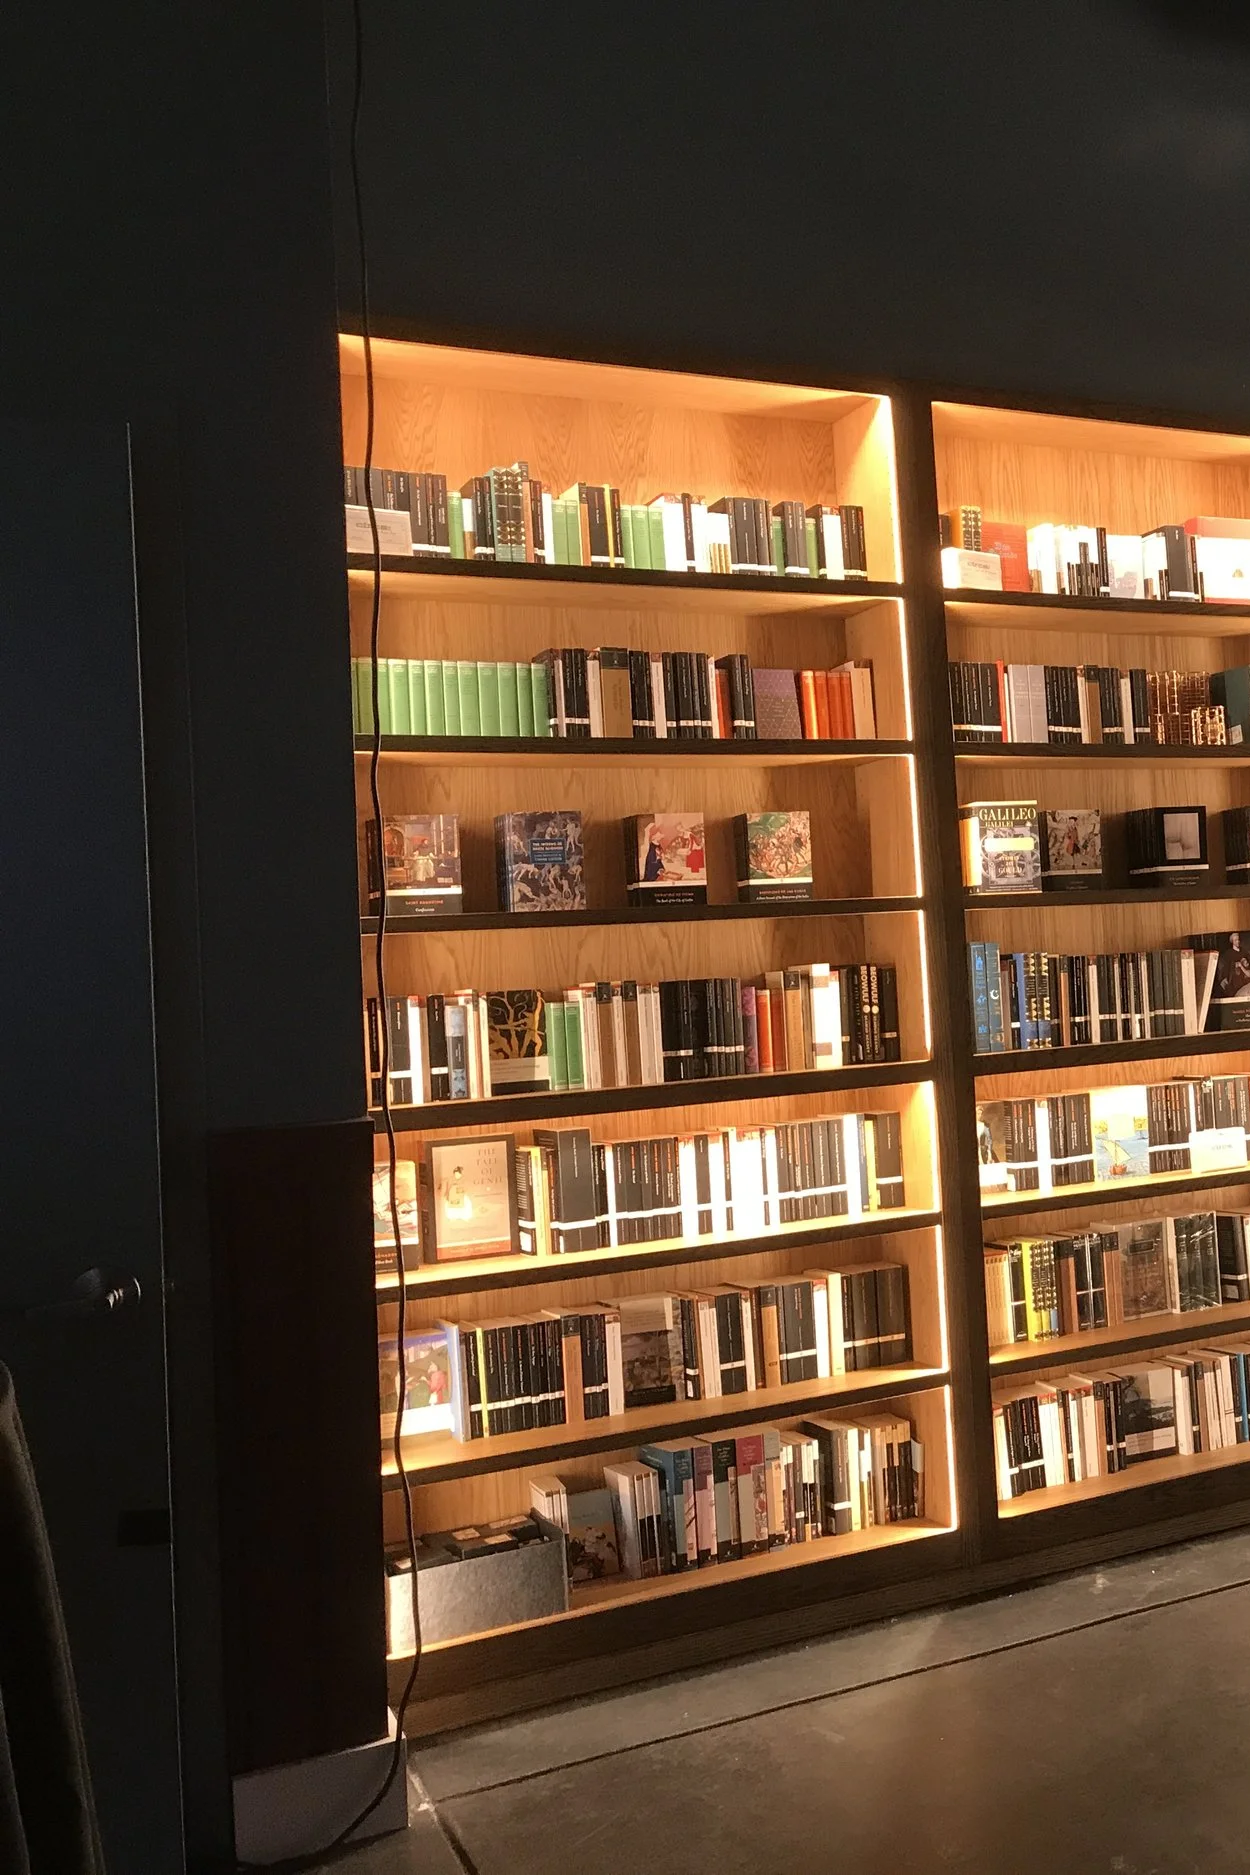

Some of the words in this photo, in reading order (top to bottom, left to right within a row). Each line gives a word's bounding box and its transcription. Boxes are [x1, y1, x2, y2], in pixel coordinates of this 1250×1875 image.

[978, 807, 1037, 821] GALILEO
[860, 965, 870, 1004] BEOWULF
[869, 966, 879, 1004] BEOWULF
[478, 1147, 497, 1157] THE
